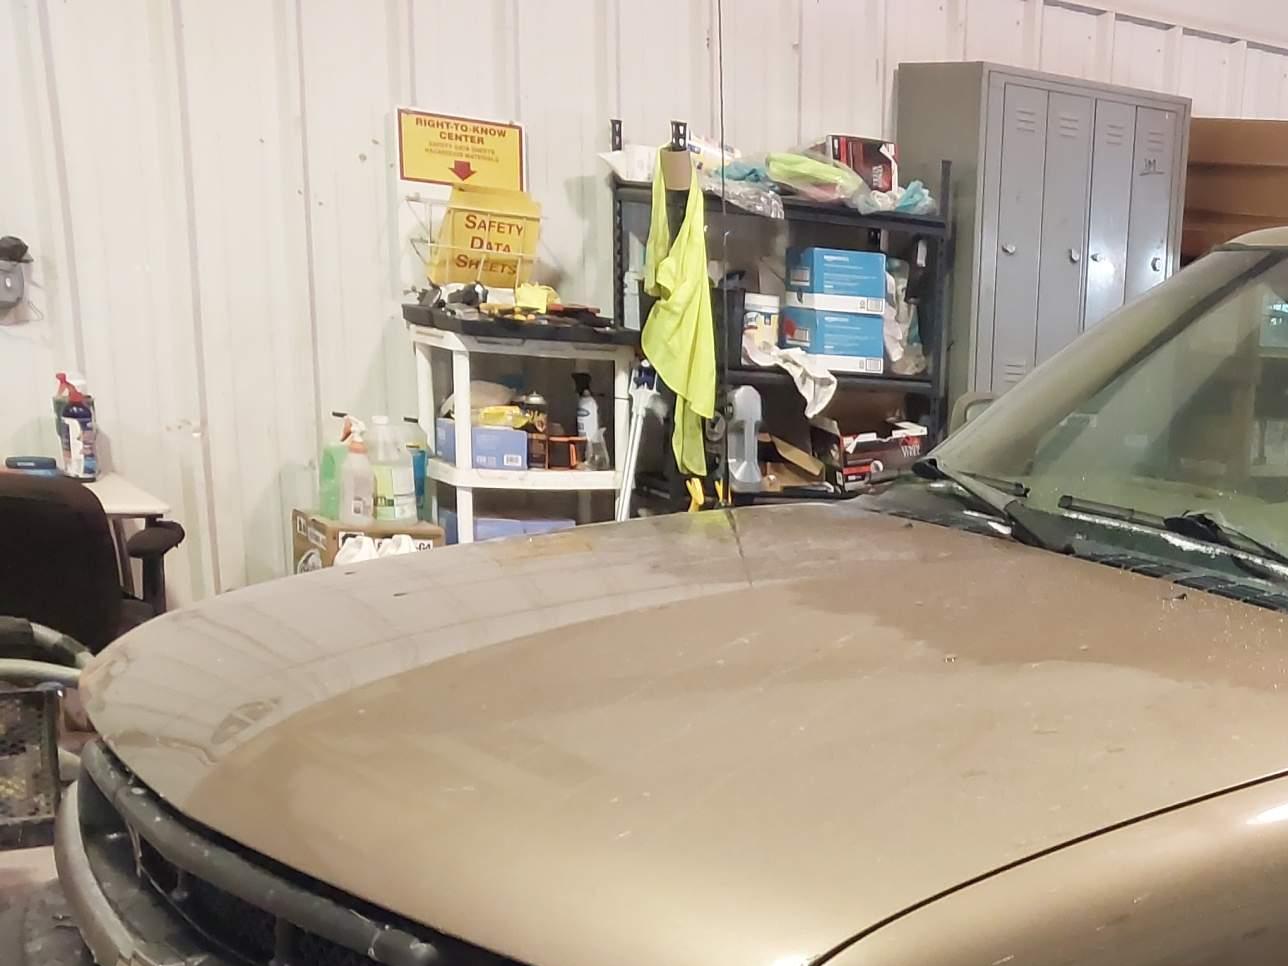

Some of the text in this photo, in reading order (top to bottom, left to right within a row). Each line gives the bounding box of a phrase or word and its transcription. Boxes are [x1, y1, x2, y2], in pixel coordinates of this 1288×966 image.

[415, 117, 507, 138] RIGHT-TO-KNOW
[439, 132, 485, 145] CENTER
[464, 213, 524, 236] SAFETY
[470, 235, 512, 253] DATA
